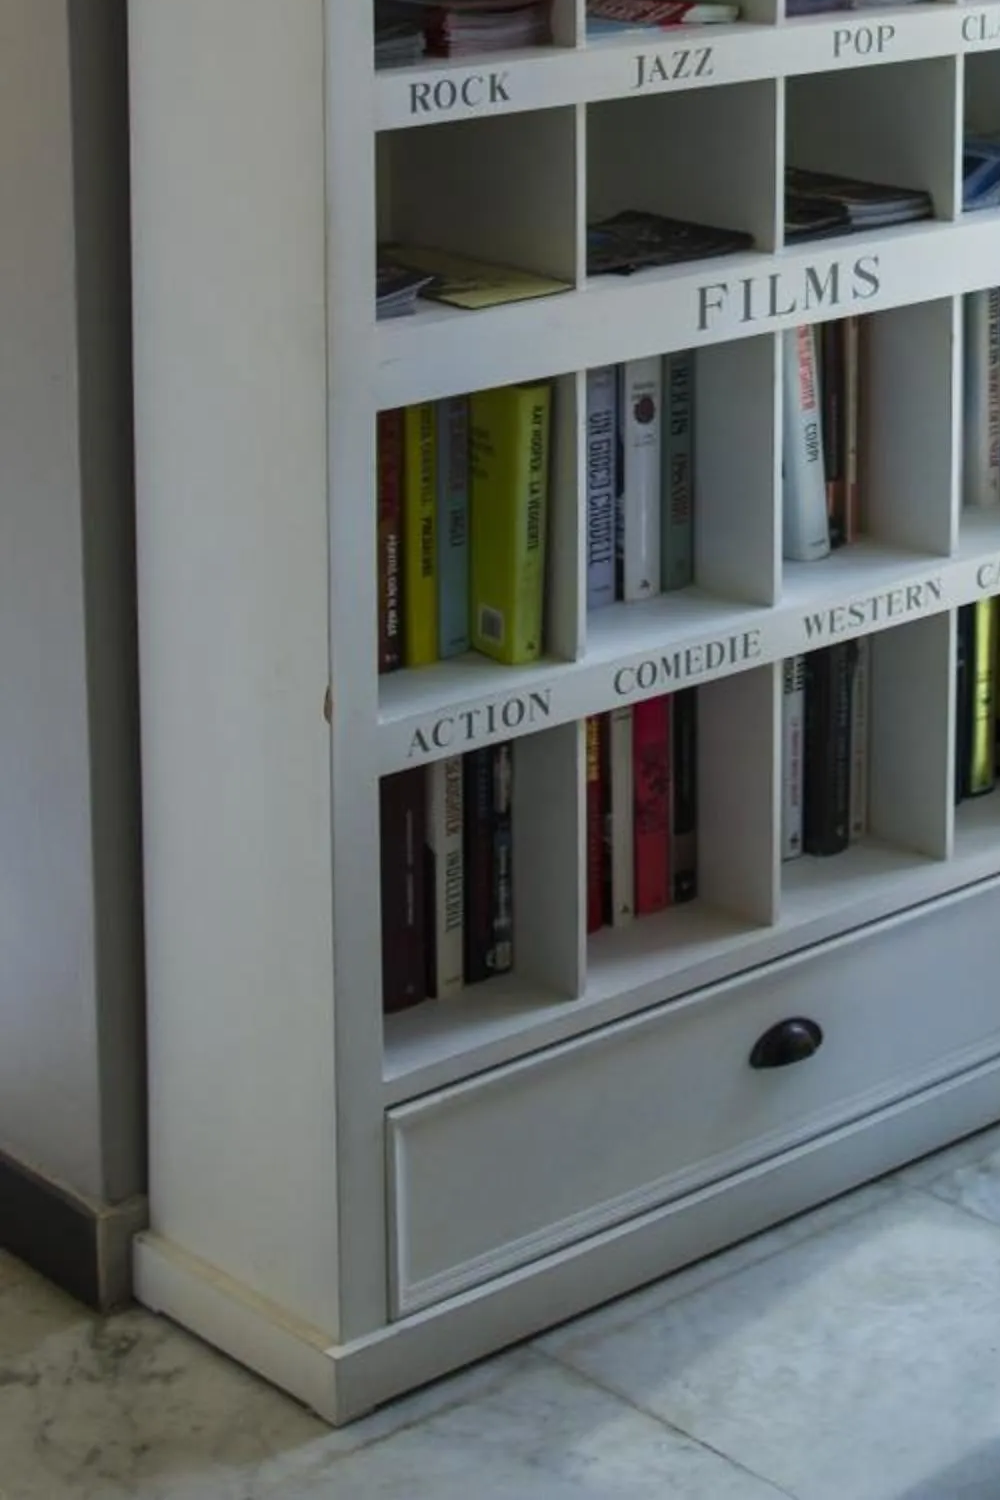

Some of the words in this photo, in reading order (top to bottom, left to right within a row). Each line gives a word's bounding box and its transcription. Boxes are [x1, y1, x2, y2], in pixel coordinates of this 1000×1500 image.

[832, 24, 897, 59] POP
[631, 46, 715, 89] JAZZ
[408, 71, 512, 116] ROCK
[695, 255, 882, 332] FILMS
[588, 410, 612, 435] UN
[804, 421, 819, 464] CORPI
[528, 481, 543, 495] LA
[588, 438, 612, 490] GIOCO
[588, 493, 612, 566] CRUDELE
[802, 576, 944, 640] WESTERN
[612, 630, 762, 697] COMEDIE
[407, 687, 553, 759] ACTION
